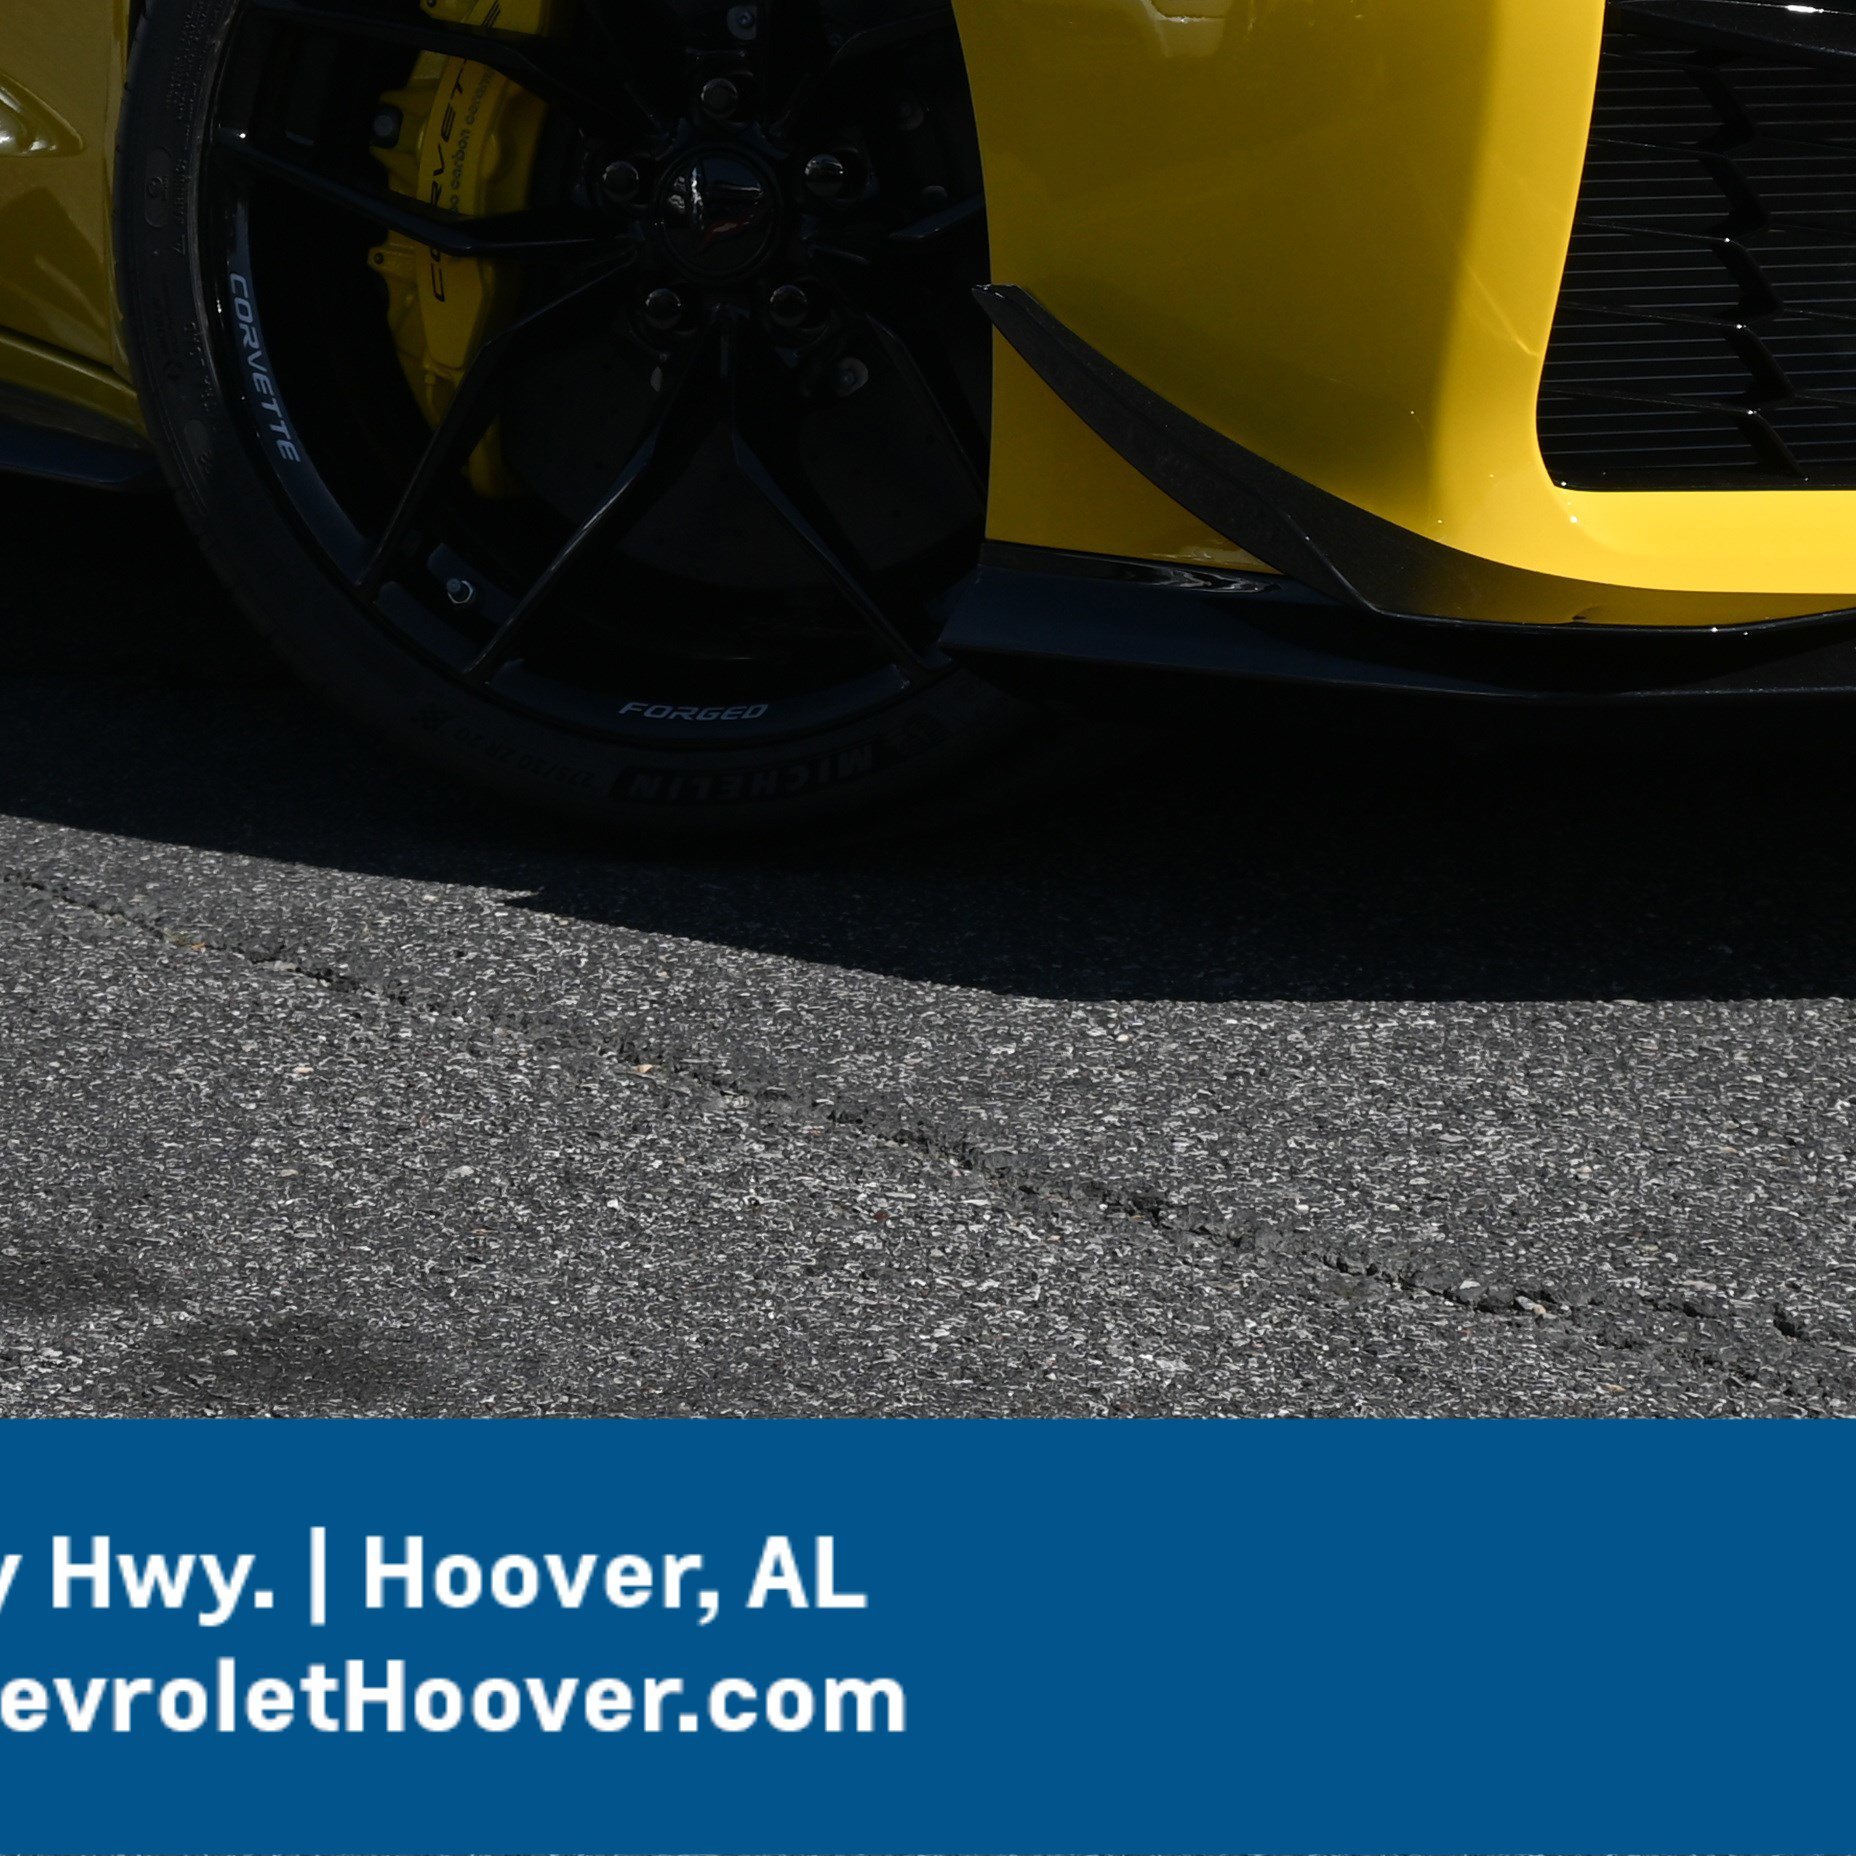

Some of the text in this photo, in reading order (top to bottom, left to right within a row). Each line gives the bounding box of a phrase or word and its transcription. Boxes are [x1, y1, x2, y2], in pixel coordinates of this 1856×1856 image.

[226, 271, 302, 463] CORVETTE
[619, 702, 768, 722] FORGED
[627, 744, 875, 802] MICHELIN
